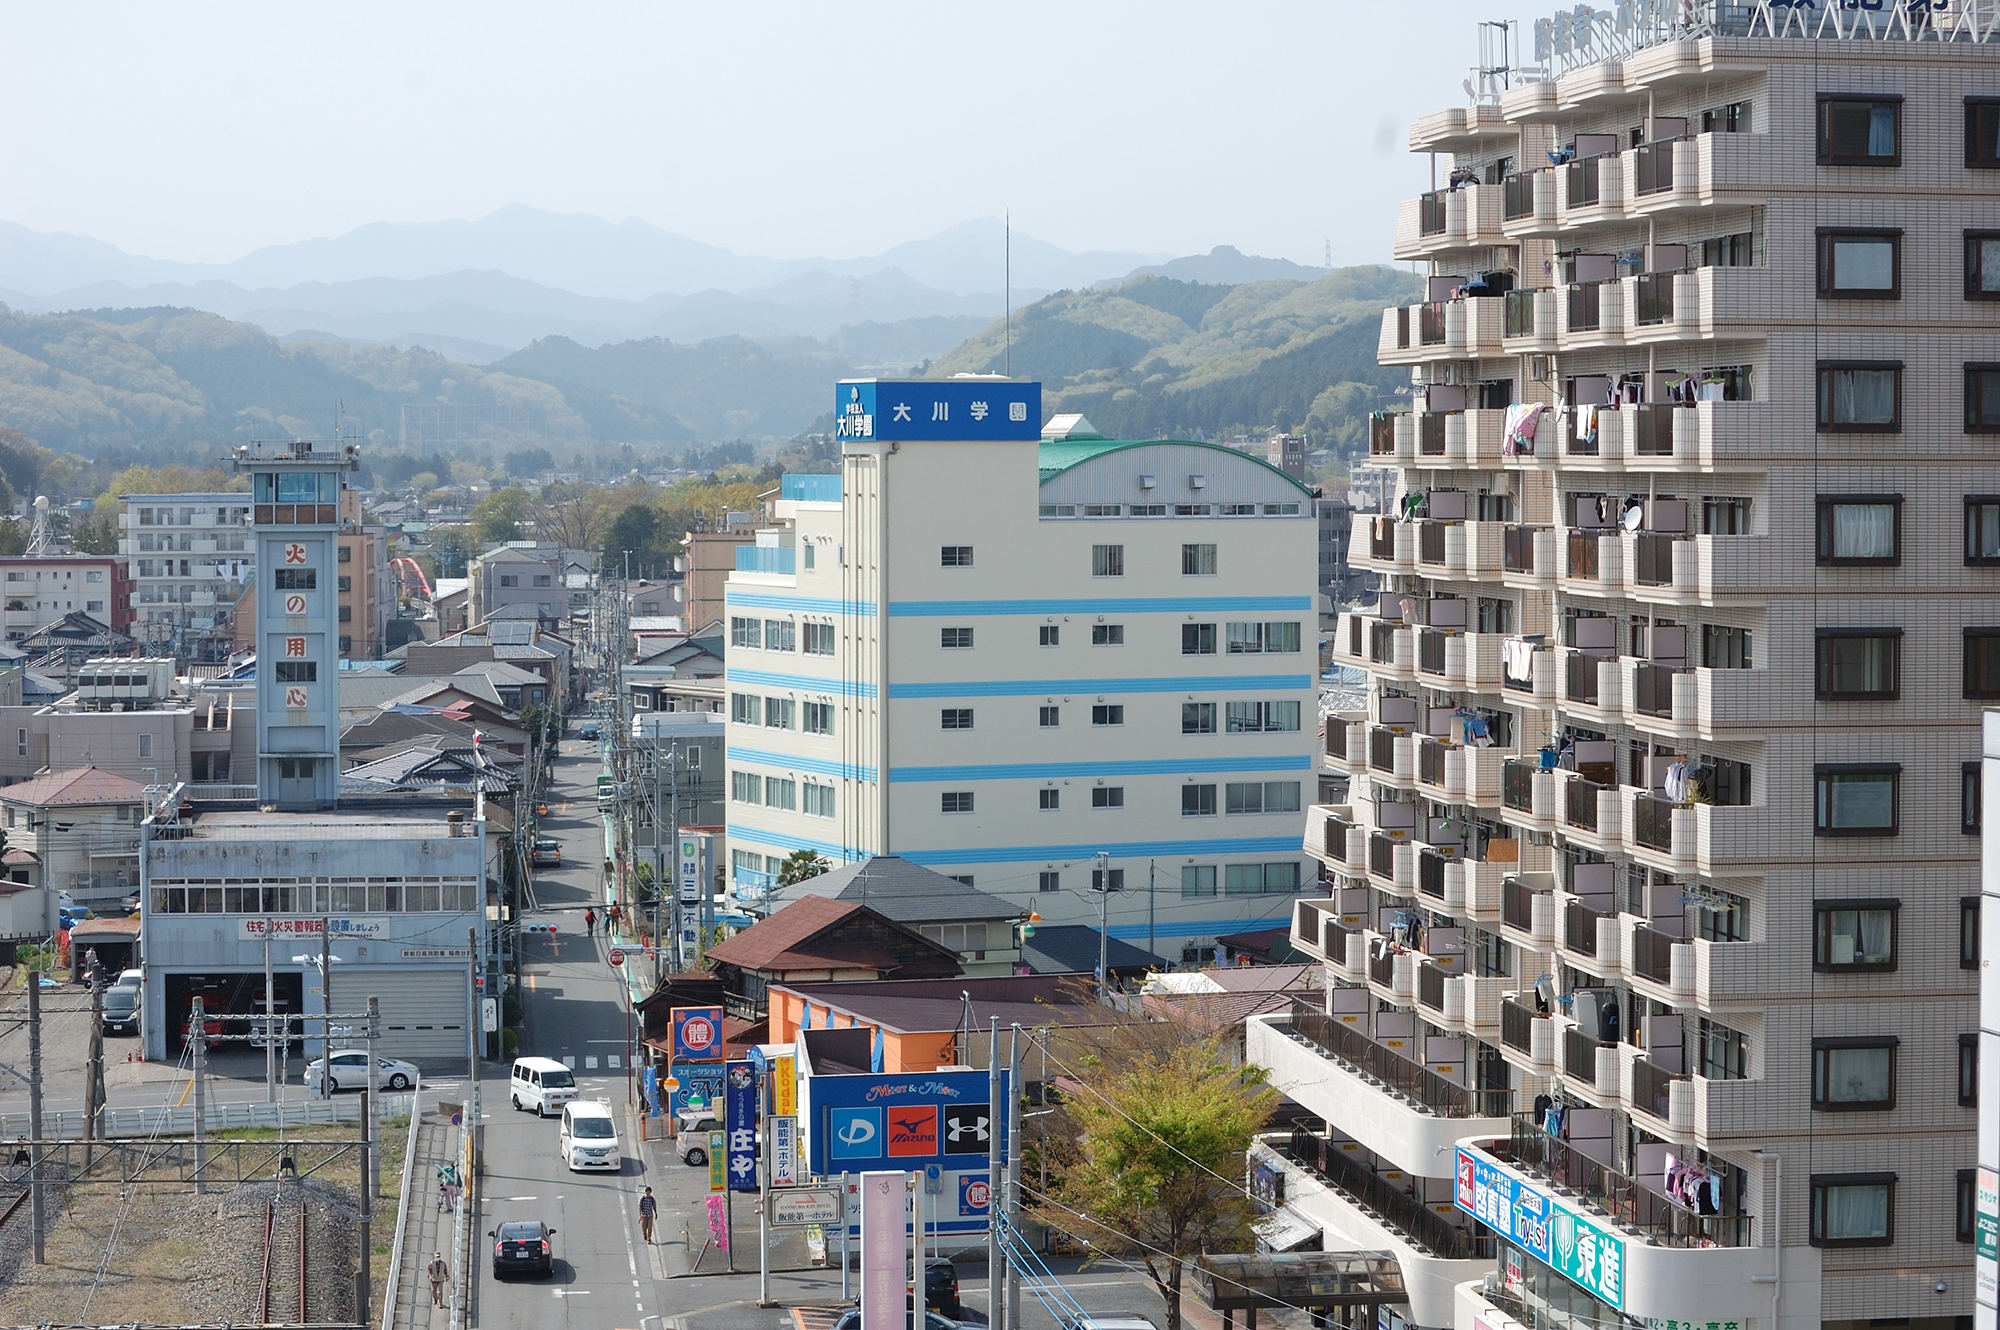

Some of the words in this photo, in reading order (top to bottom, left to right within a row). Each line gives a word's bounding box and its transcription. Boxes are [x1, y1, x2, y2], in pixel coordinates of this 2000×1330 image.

[893, 401, 1027, 422] 大川学園
[837, 414, 873, 437] 大川学園
[286, 544, 307, 707] 火の用心
[246, 919, 380, 933] 住宅火災警報器設置しましょう
[677, 1068, 726, 1077] スポーツショッ
[908, 1083, 917, 1093] &
[730, 1127, 754, 1179] 庄や
[777, 1119, 790, 1178] 飯能第一ホテル
[778, 1210, 835, 1222] 飯能第一ホテル
[1576, 1224, 1620, 1304] 東進
